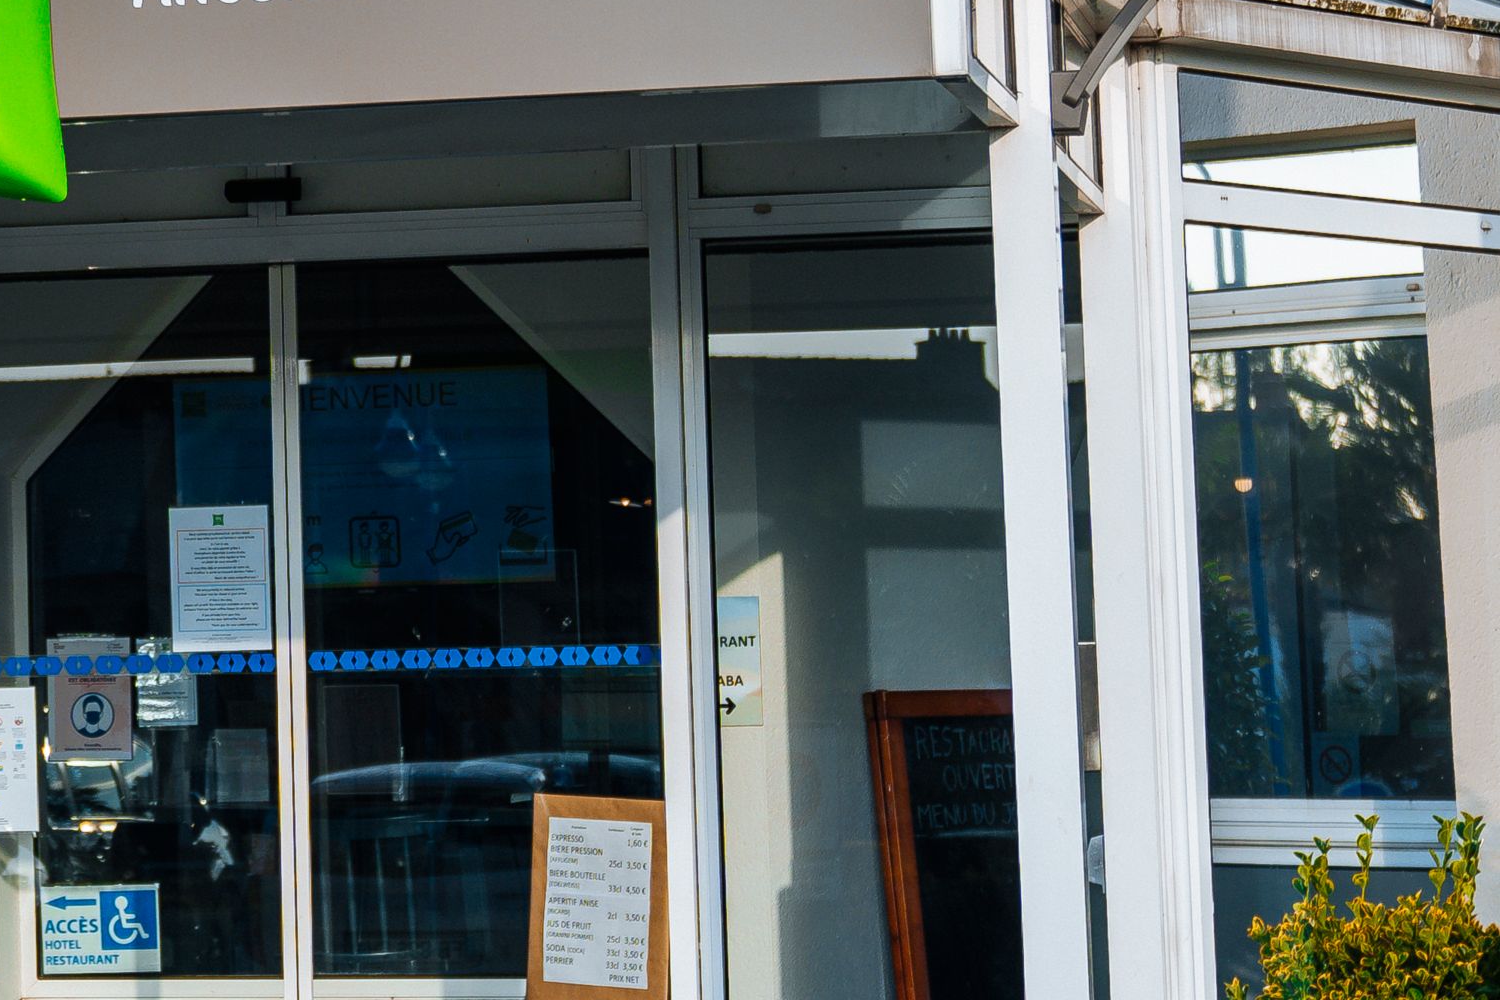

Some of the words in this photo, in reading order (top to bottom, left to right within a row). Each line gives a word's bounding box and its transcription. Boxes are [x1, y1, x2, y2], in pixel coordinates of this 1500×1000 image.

[551, 833, 584, 844] EXPRESSO
[627, 839, 642, 848] 1,60
[643, 840, 648, 848] €
[570, 847, 603, 856] PRESSION
[608, 860, 622, 869] 25cl
[626, 861, 641, 870] 3,50
[643, 862, 647, 870] €
[570, 871, 606, 881] BOUTEILLE
[608, 884, 621, 893] 33cl
[625, 886, 640, 895] 4,50
[642, 887, 646, 895] €
[548, 897, 577, 907] APERITIF
[607, 911, 617, 920] 2cl
[625, 913, 640, 922] 3,50
[641, 914, 646, 922] €
[45, 916, 98, 934] ACCÈS
[547, 920, 559, 929] JUS
[560, 920, 570, 929] DE
[571, 921, 591, 930] FRUIT
[45, 940, 82, 950] HOTEL
[606, 935, 620, 944] 25cl
[624, 937, 639, 945] 3,50
[640, 938, 645, 946] €
[546, 944, 565, 953] SODA
[606, 949, 620, 957] 33cl
[624, 950, 638, 959] 3,50
[640, 951, 644, 959] €
[46, 954, 120, 966] RESTAURANT
[546, 956, 574, 966] PERRIER
[605, 961, 619, 970] 33cl
[622, 963, 637, 972] 3,50
[638, 964, 643, 972] €
[609, 974, 624, 983] PRIX
[625, 975, 639, 984] NET
